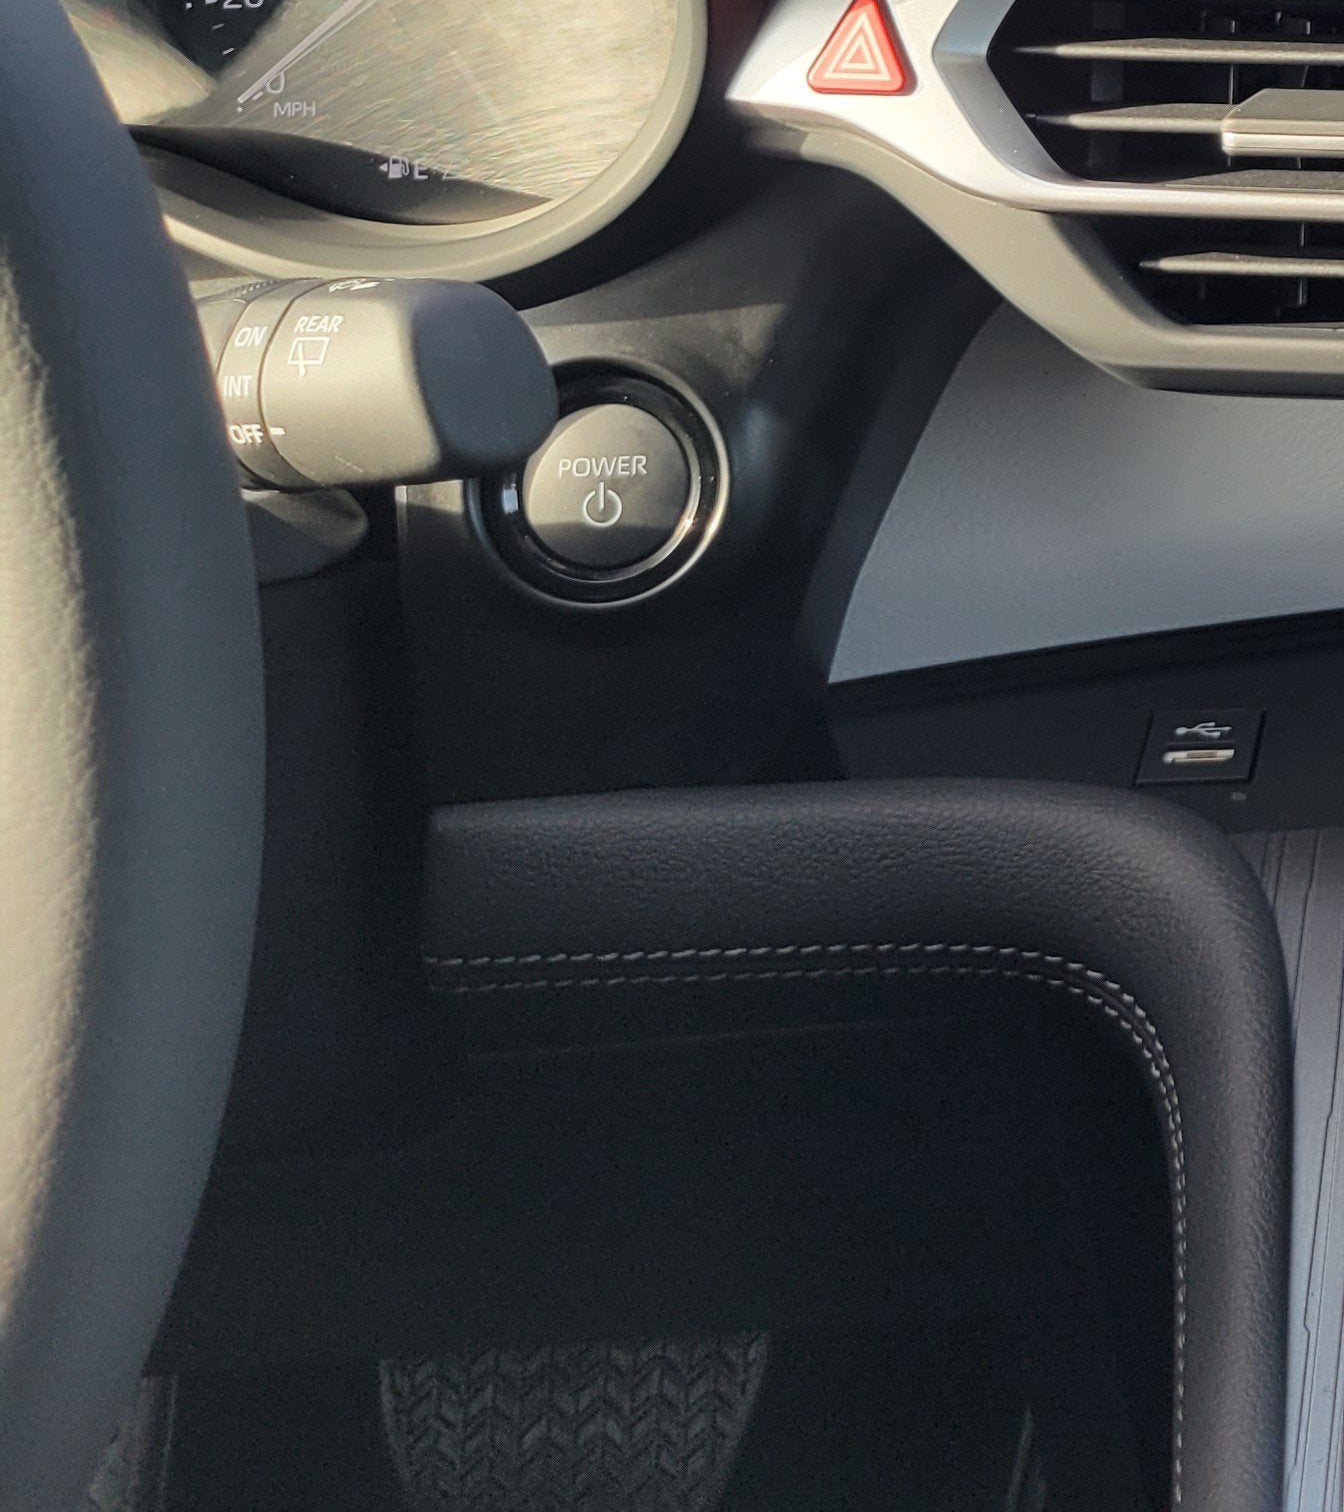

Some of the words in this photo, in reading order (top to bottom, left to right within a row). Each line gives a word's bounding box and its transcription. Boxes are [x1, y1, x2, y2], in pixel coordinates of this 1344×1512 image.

[274, 100, 316, 118] MPH
[235, 326, 267, 347] ON
[294, 315, 344, 333] REAR
[223, 375, 254, 397] INT
[228, 424, 263, 444] OFF
[558, 455, 648, 478] POWER
